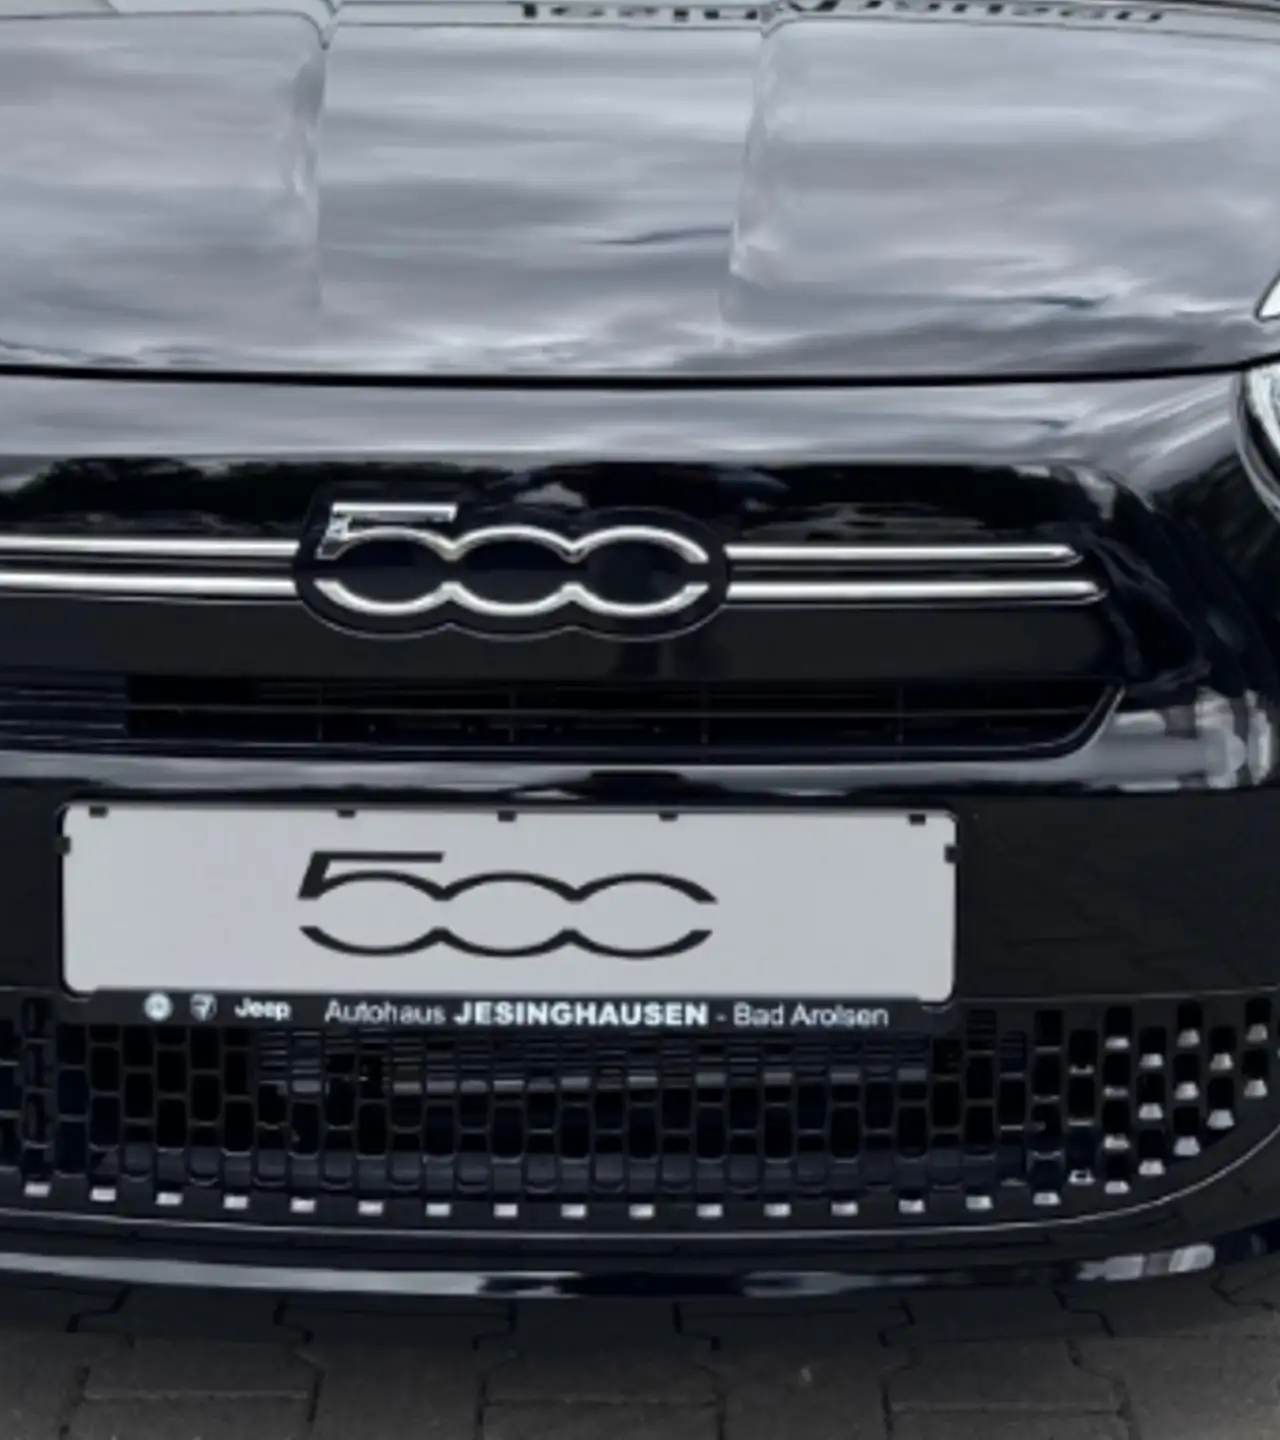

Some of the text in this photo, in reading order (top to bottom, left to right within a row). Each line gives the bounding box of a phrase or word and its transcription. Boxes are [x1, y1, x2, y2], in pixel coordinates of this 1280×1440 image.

[314, 502, 710, 616] 500
[298, 850, 717, 960] 500
[234, 995, 292, 1021] Jeep
[324, 998, 446, 1026] Autohaus
[453, 1000, 709, 1027] JESINGHAUSEN
[733, 1002, 786, 1027] Bad
[790, 1002, 890, 1028] Arolsen
